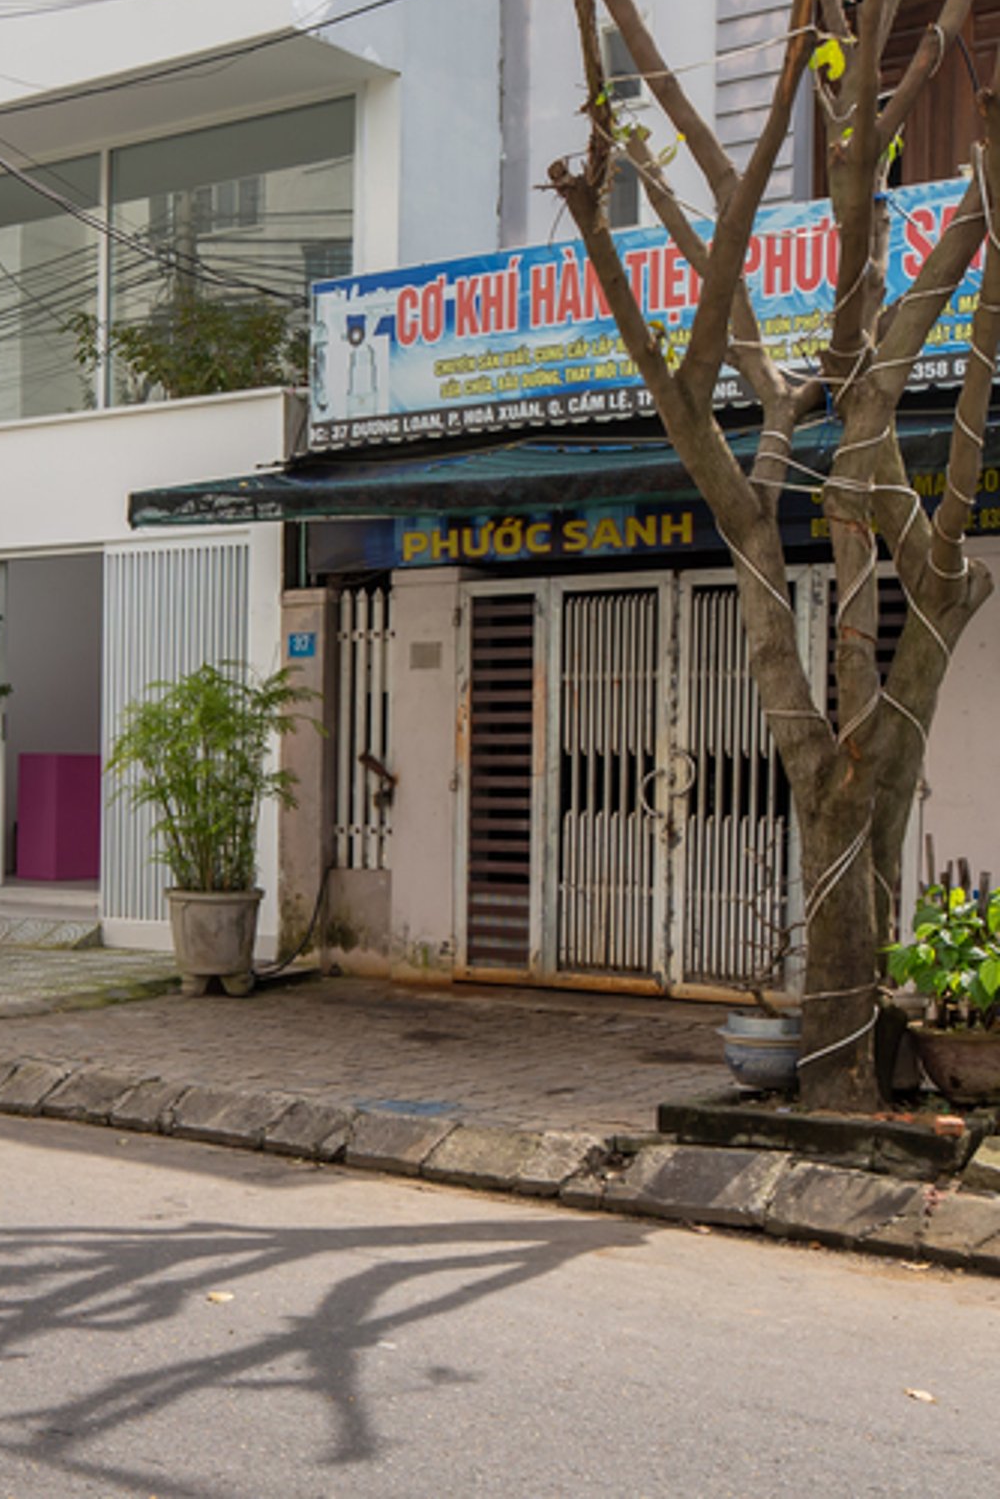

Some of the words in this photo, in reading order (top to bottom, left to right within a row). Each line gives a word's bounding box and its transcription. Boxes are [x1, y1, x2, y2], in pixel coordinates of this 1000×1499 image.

[397, 274, 446, 346] CƠ
[455, 256, 521, 337] KHÍ
[402, 516, 552, 562] PHƯỚC
[562, 511, 694, 551] SANH
